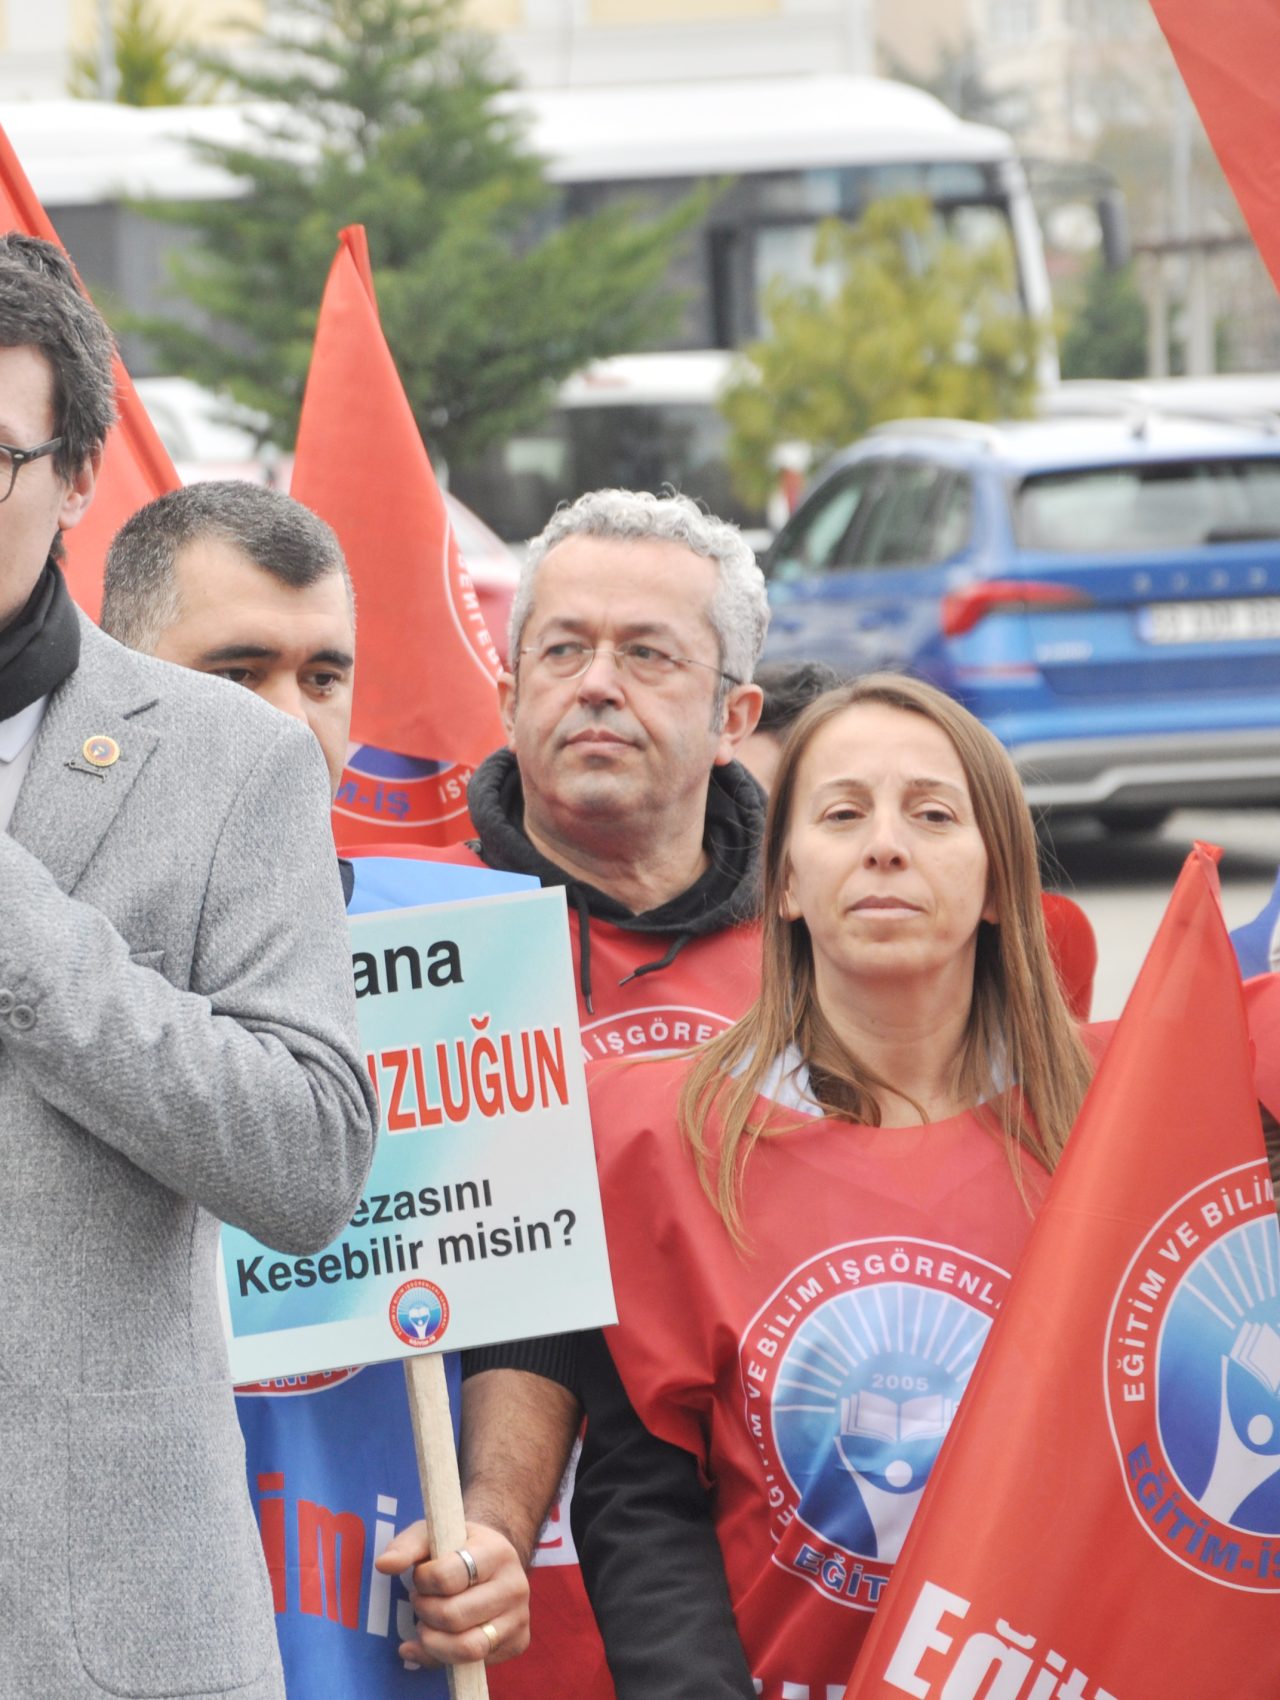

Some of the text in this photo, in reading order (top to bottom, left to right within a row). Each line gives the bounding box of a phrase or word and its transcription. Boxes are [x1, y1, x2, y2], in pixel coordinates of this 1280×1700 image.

[353, 938, 465, 999] ana
[593, 1016, 726, 1055] İŞGÖRE
[351, 1179, 494, 1228] ezasını
[236, 1208, 578, 1297] Kesebilir misin?
[828, 1247, 1003, 1310] İŞGÖRENL
[756, 1276, 825, 1360] BİLİM
[1116, 1268, 1167, 1402] EĞİTİM
[1158, 1221, 1200, 1263] VE
[746, 1360, 769, 1399] VE
[871, 1371, 930, 1391] 2005
[1127, 1440, 1280, 1579] EĞİTİM-İ
[794, 1543, 889, 1603] EĞİT
